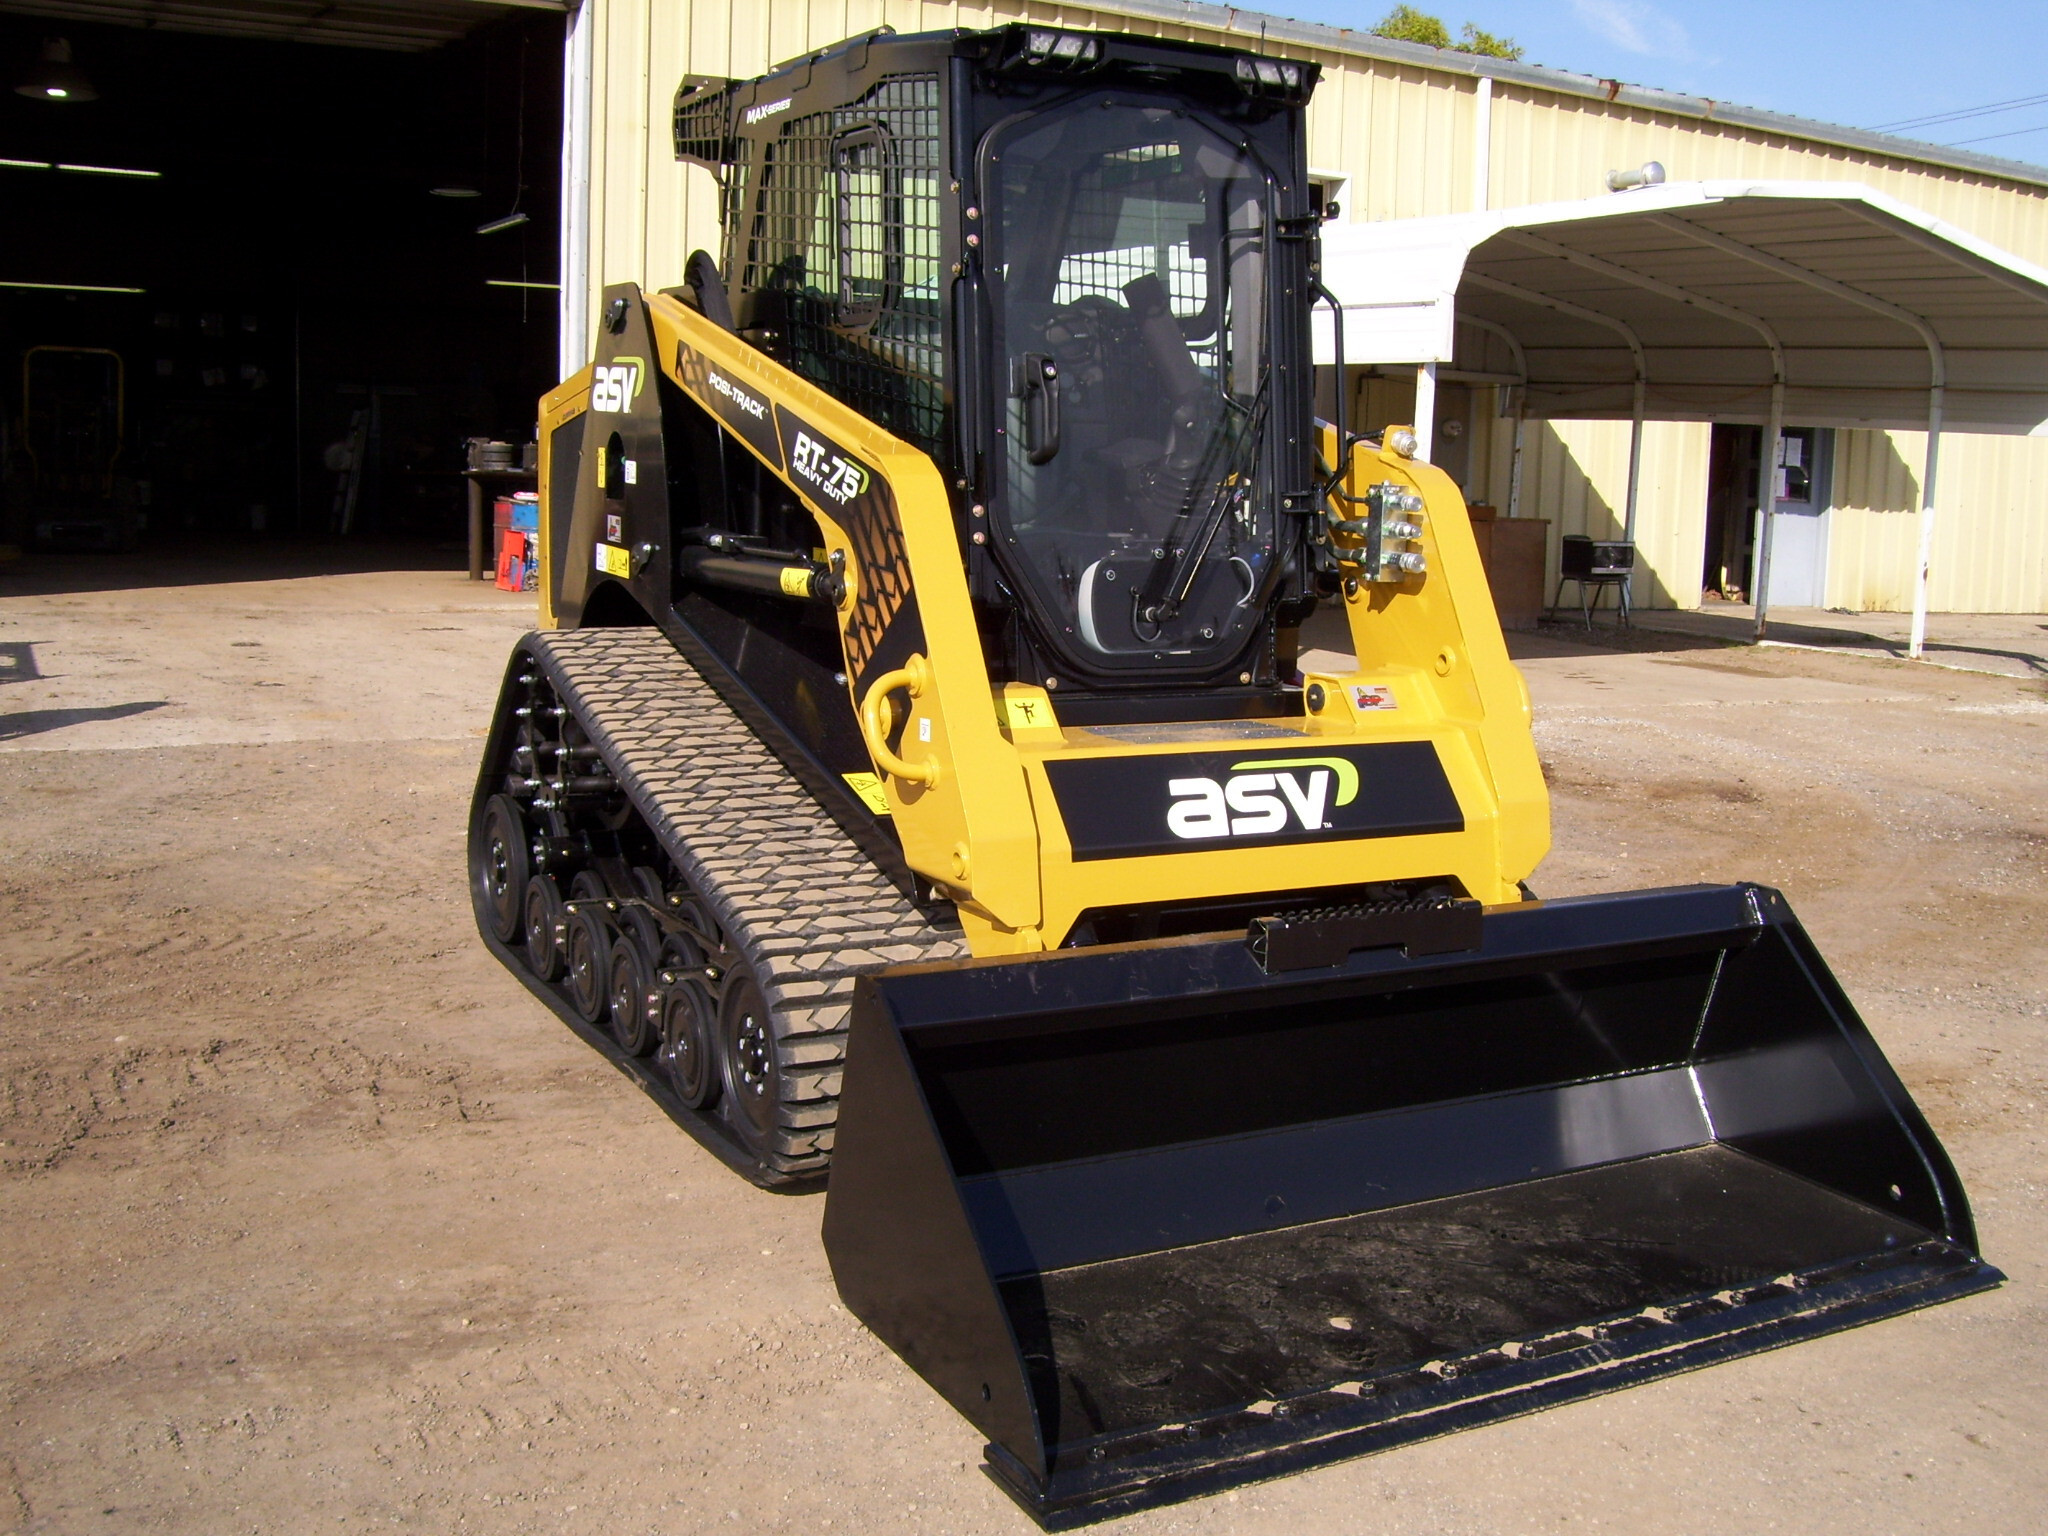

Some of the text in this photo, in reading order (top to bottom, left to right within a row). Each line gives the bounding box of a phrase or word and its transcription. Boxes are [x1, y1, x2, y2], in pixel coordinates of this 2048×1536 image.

[708, 371, 765, 421] POSI-TRACK
[792, 457, 849, 506] HEAVY DUTY
[793, 431, 861, 499] RT-75
